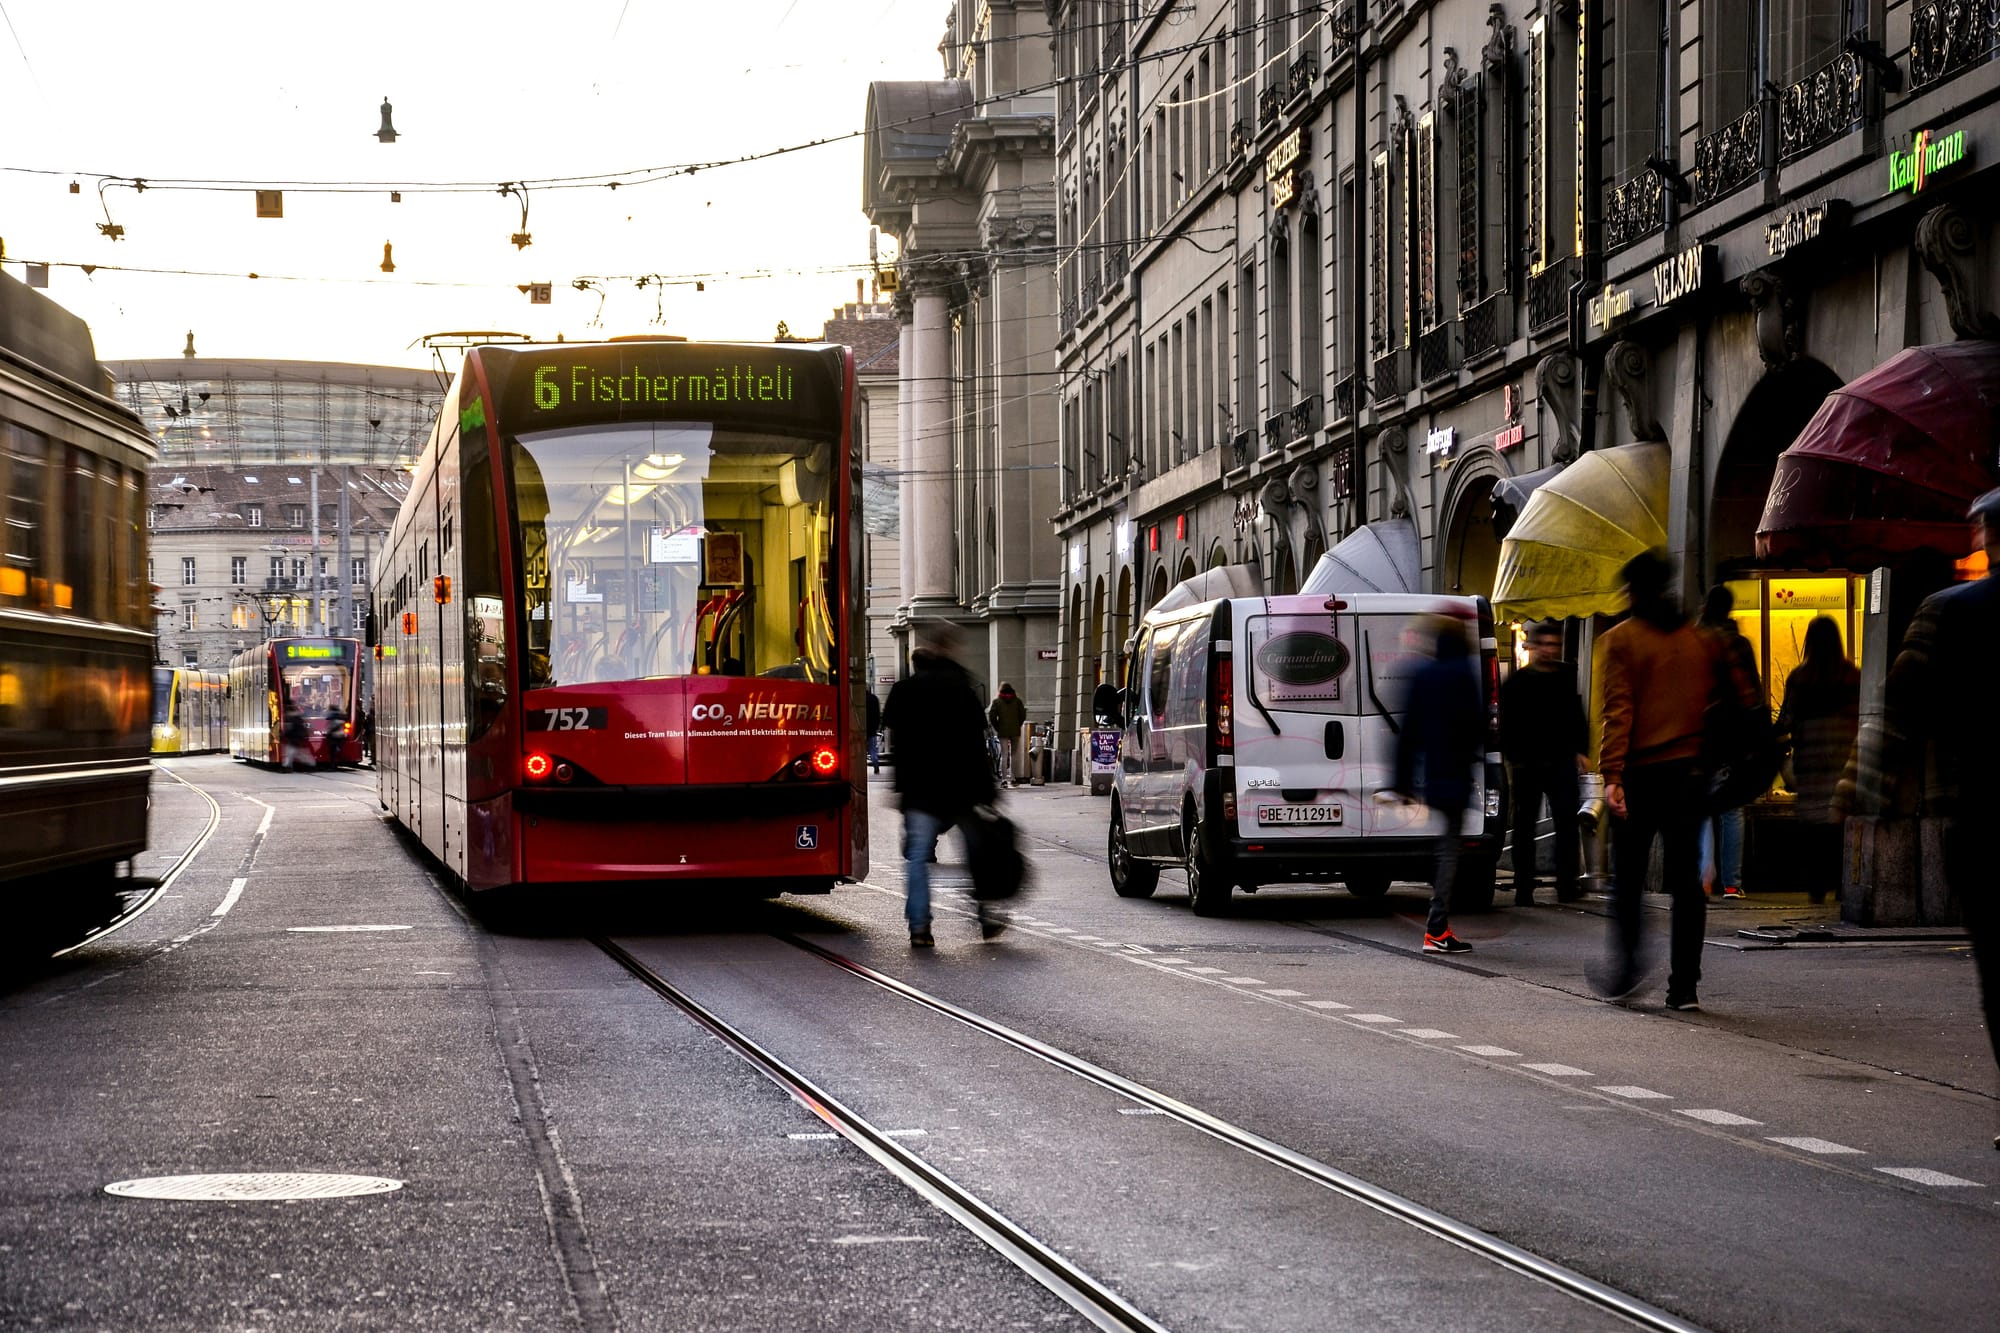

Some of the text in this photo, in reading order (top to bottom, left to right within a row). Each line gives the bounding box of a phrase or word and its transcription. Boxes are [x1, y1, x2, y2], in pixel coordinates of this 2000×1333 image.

[1889, 129, 1964, 194] Kauffmann
[1653, 244, 1703, 308] NELSON
[533, 287, 550, 301] 15
[1589, 283, 1633, 331] Kauffmann
[534, 364, 793, 410] 6 Fischermätteli
[1266, 650, 1336, 664] Caramelina
[544, 707, 590, 732] 752
[738, 703, 833, 721] NEUTRAL
[666, 730, 684, 738] fährt
[688, 729, 738, 737] klimaschonend
[751, 728, 787, 736] Elektrizität
[1247, 779, 1281, 787] OPEL
